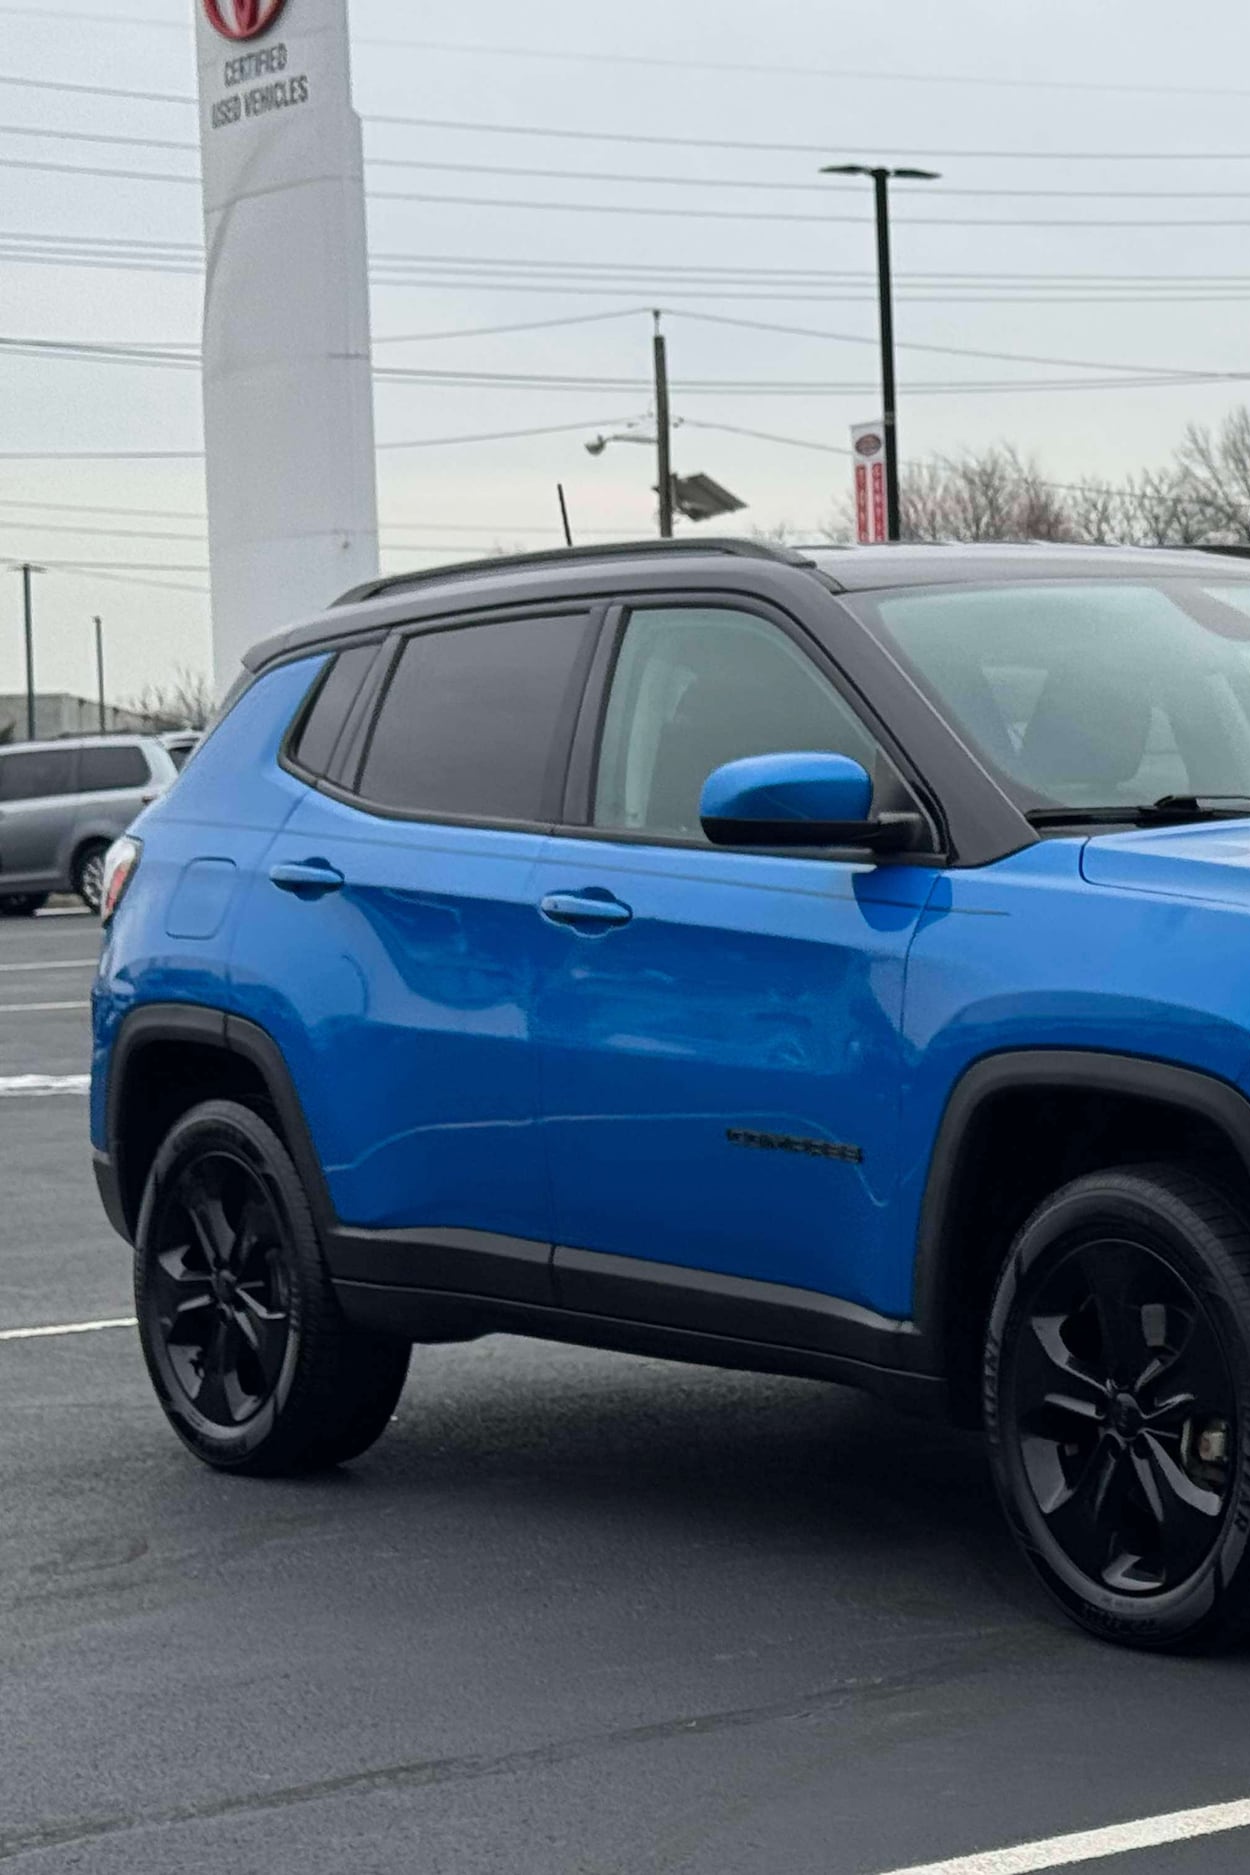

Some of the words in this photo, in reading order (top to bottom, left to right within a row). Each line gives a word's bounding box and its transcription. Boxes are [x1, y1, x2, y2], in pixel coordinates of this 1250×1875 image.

[224, 43, 288, 88] CERTIFIED
[211, 94, 242, 130] USED
[244, 74, 309, 118] VEHICLES
